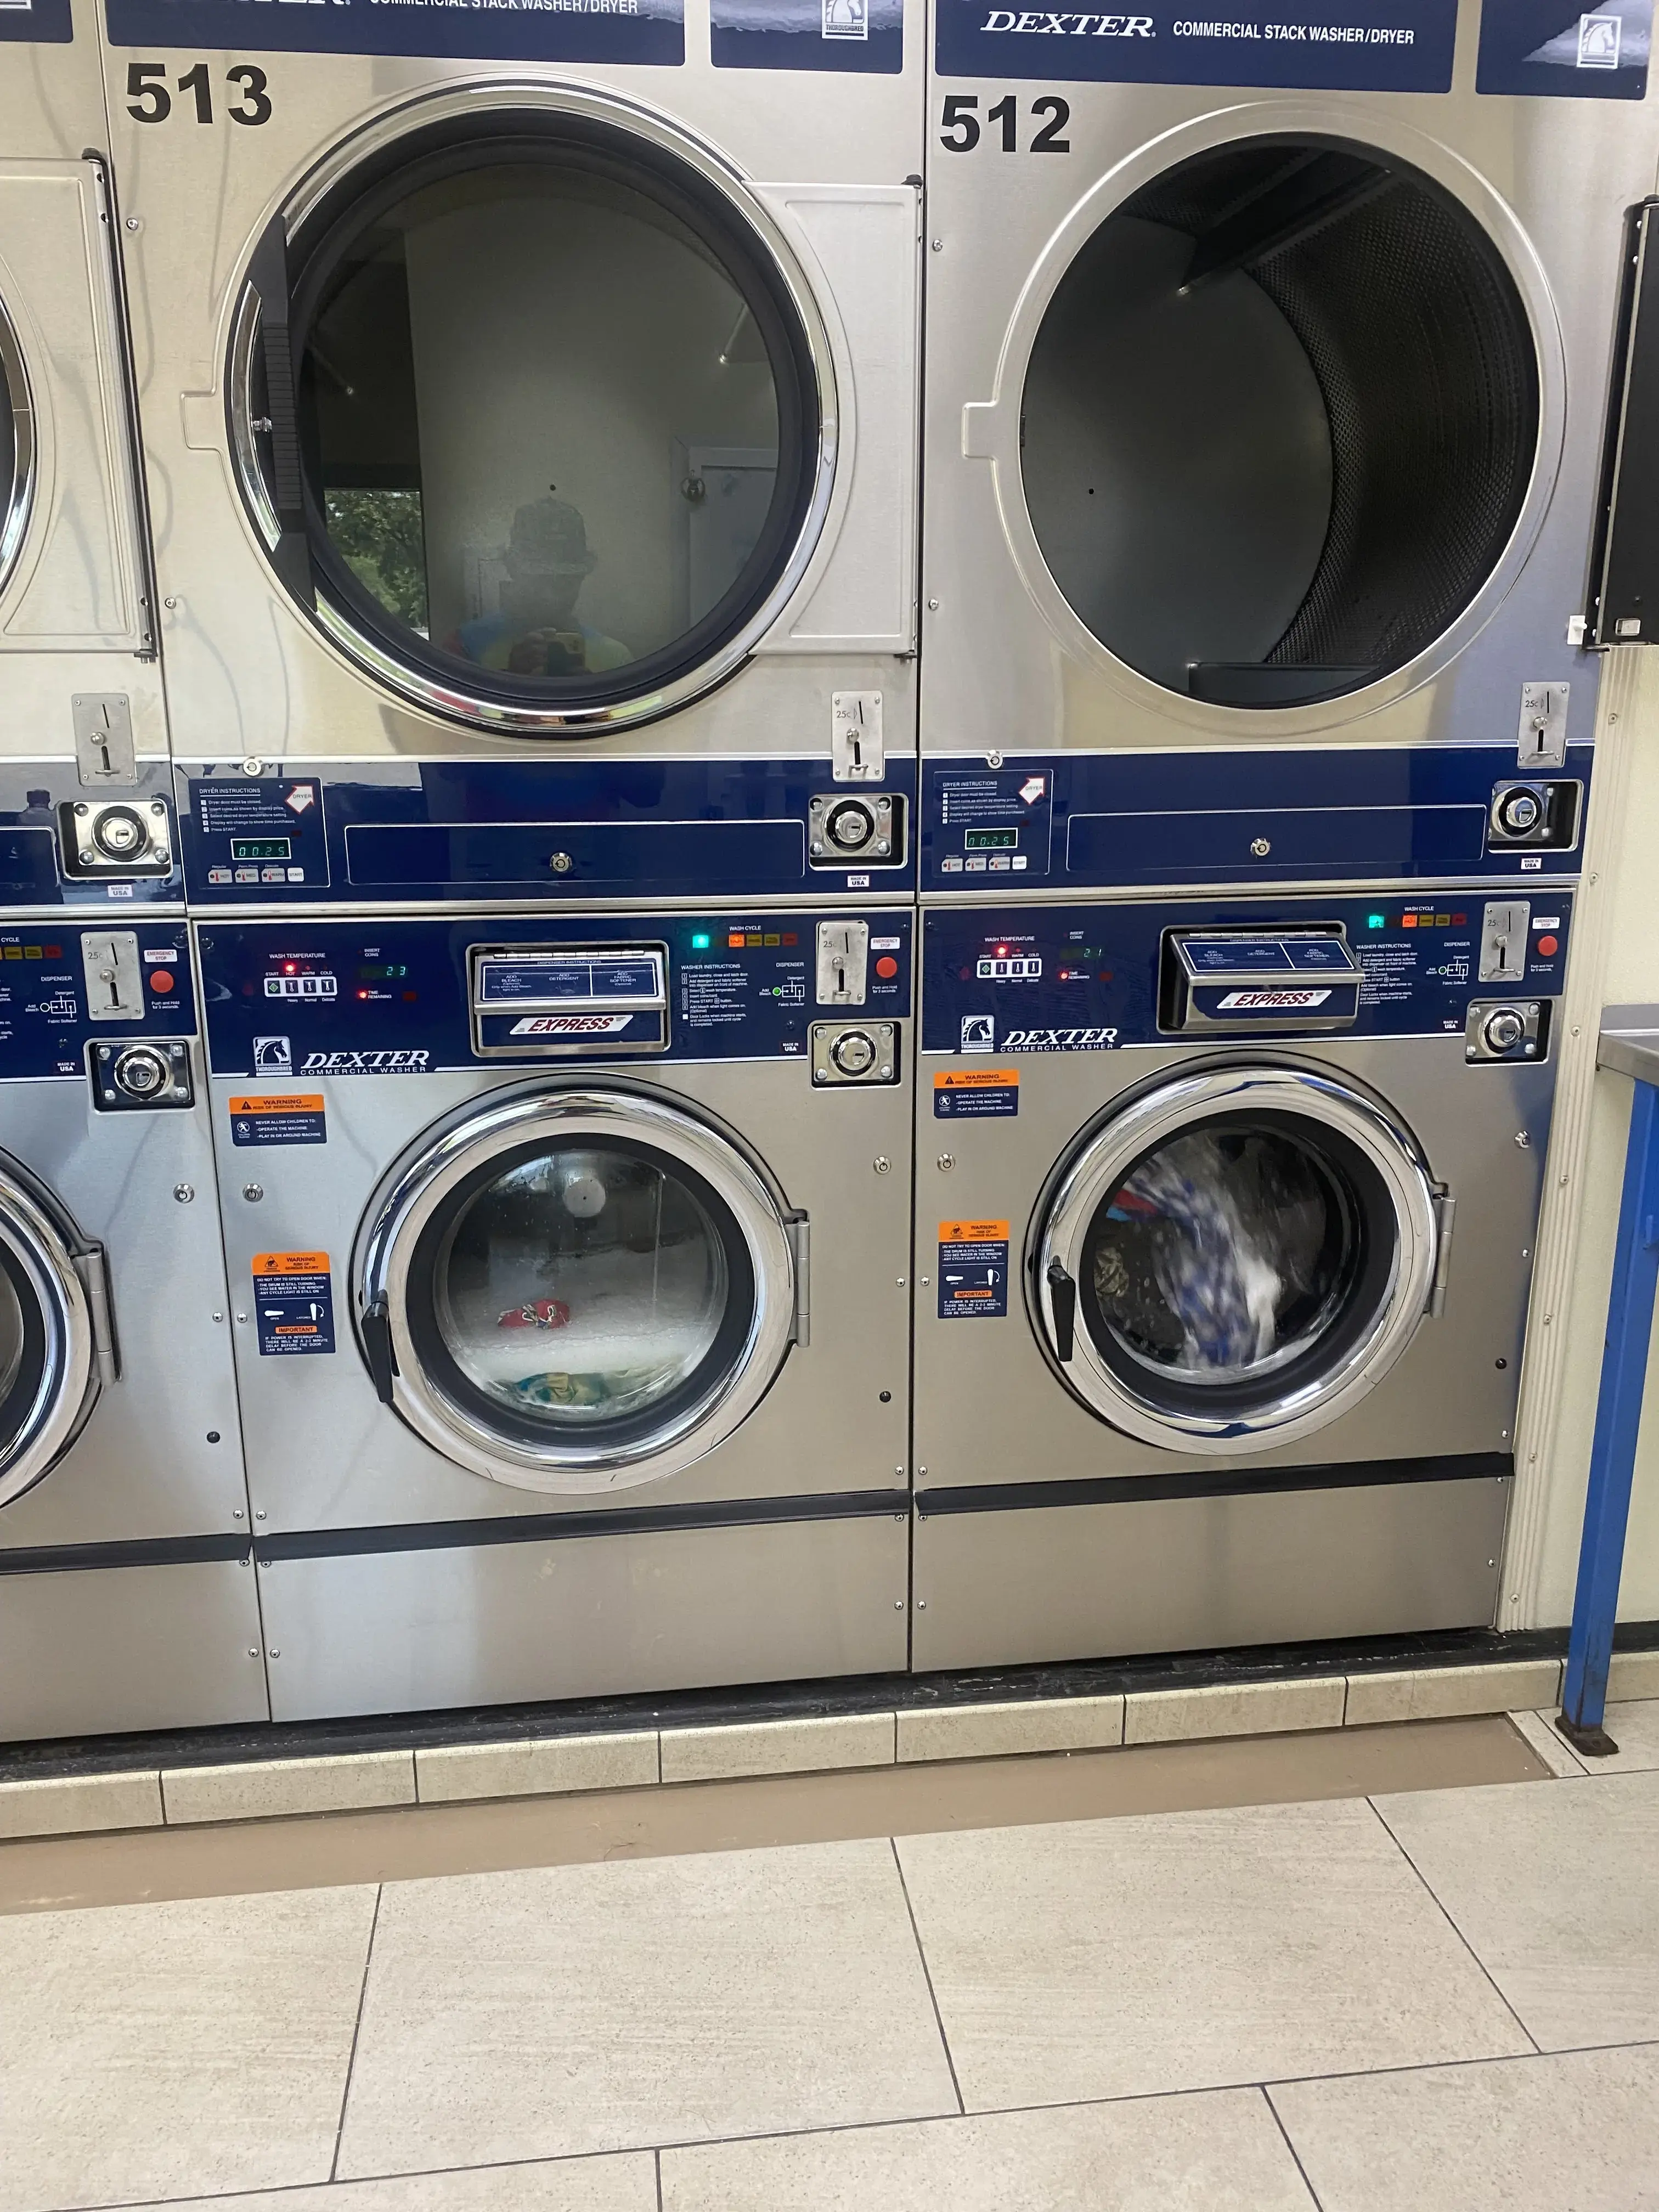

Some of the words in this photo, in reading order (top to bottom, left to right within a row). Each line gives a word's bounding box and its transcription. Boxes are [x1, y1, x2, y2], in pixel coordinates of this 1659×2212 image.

[980, 10, 1153, 37] DEXTER
[1173, 21, 1261, 38] COMMERCIAL
[1265, 25, 1306, 40] STACK
[1310, 26, 1414, 44] WASHER/DRYER
[126, 63, 272, 125] 513
[939, 95, 1071, 153] 512
[1233, 992, 1313, 1006] EXPRESS
[527, 1018, 613, 1031] EXPRESS
[1001, 1028, 1118, 1046] DEXTER
[301, 1050, 429, 1069] DEXTER
